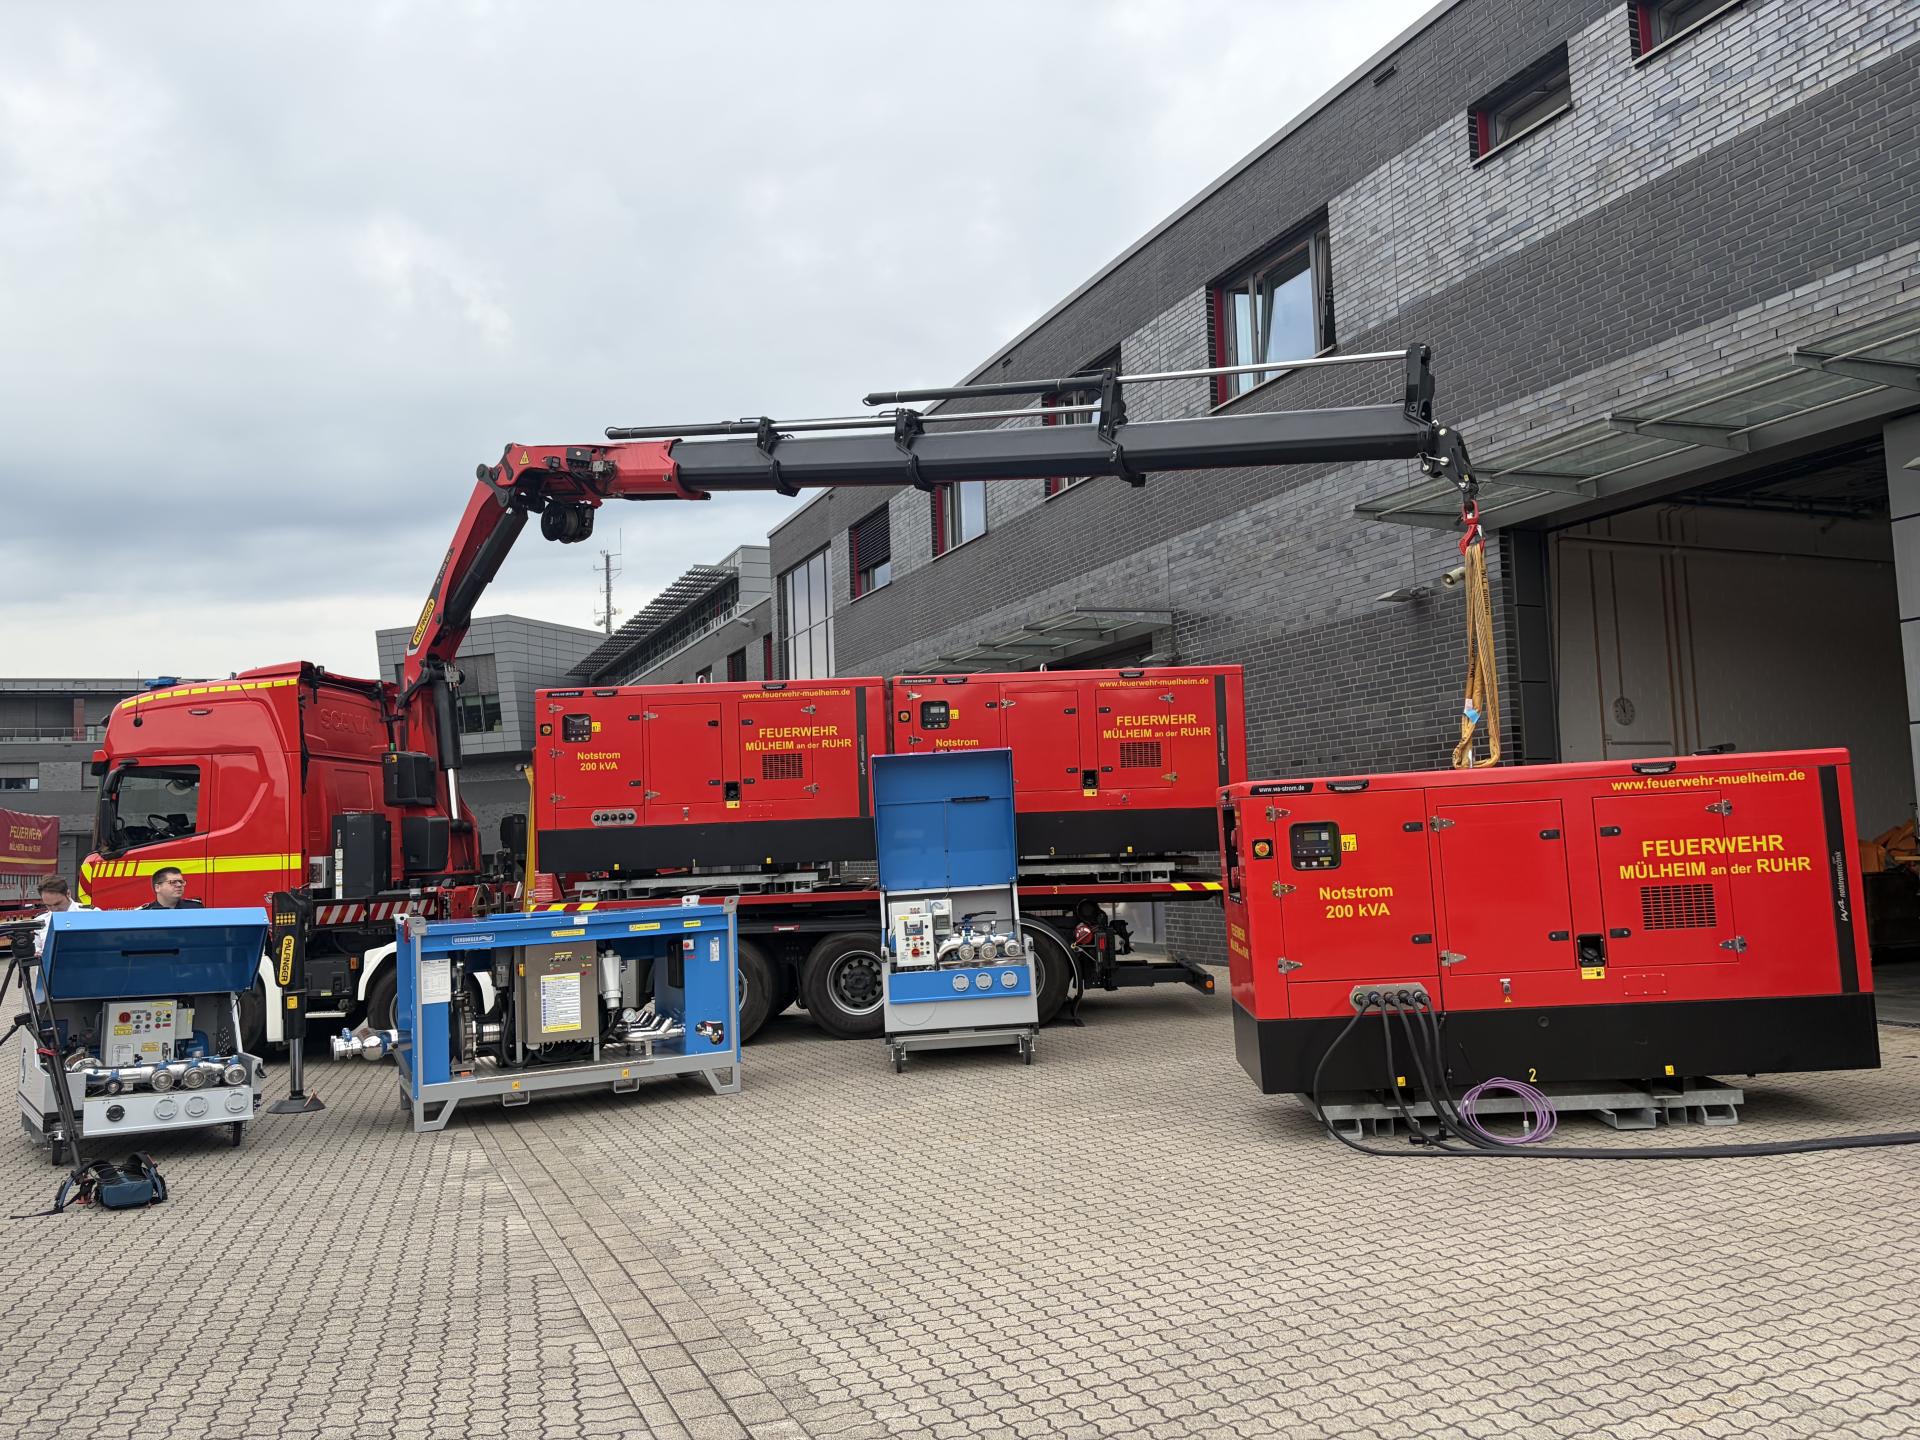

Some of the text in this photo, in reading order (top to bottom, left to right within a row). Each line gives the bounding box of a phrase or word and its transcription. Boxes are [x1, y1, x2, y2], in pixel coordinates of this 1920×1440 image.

[414, 601, 434, 644] PALFINGER
[1098, 678, 1209, 688] www.feuerwehr-muelheim.de
[742, 688, 851, 700] www.feuerwehr-muelheim.de
[1116, 714, 1197, 727] FEUERWEHR
[759, 725, 839, 739] FEUERWEHR
[1103, 727, 1153, 739] MÜLHEIM
[1180, 727, 1212, 737] RUHR
[745, 740, 794, 752] MÜLHEIM
[821, 738, 853, 749] RUHR
[935, 738, 979, 747] Notstrom
[577, 751, 621, 760] Notstrom
[580, 761, 618, 771] 200 kVA
[1611, 770, 1806, 791] www.feuerwehr-muelheim.de
[1049, 846, 1056, 856] 3
[1641, 834, 1785, 858] FEUERWEHR
[1619, 856, 1812, 880] MÜLHEIM an der RUHR
[1319, 885, 1394, 901] Notstrom
[1325, 902, 1391, 919] 200 kVA
[281, 937, 293, 983] PALFINGER
[1528, 1067, 1538, 1083] 2
